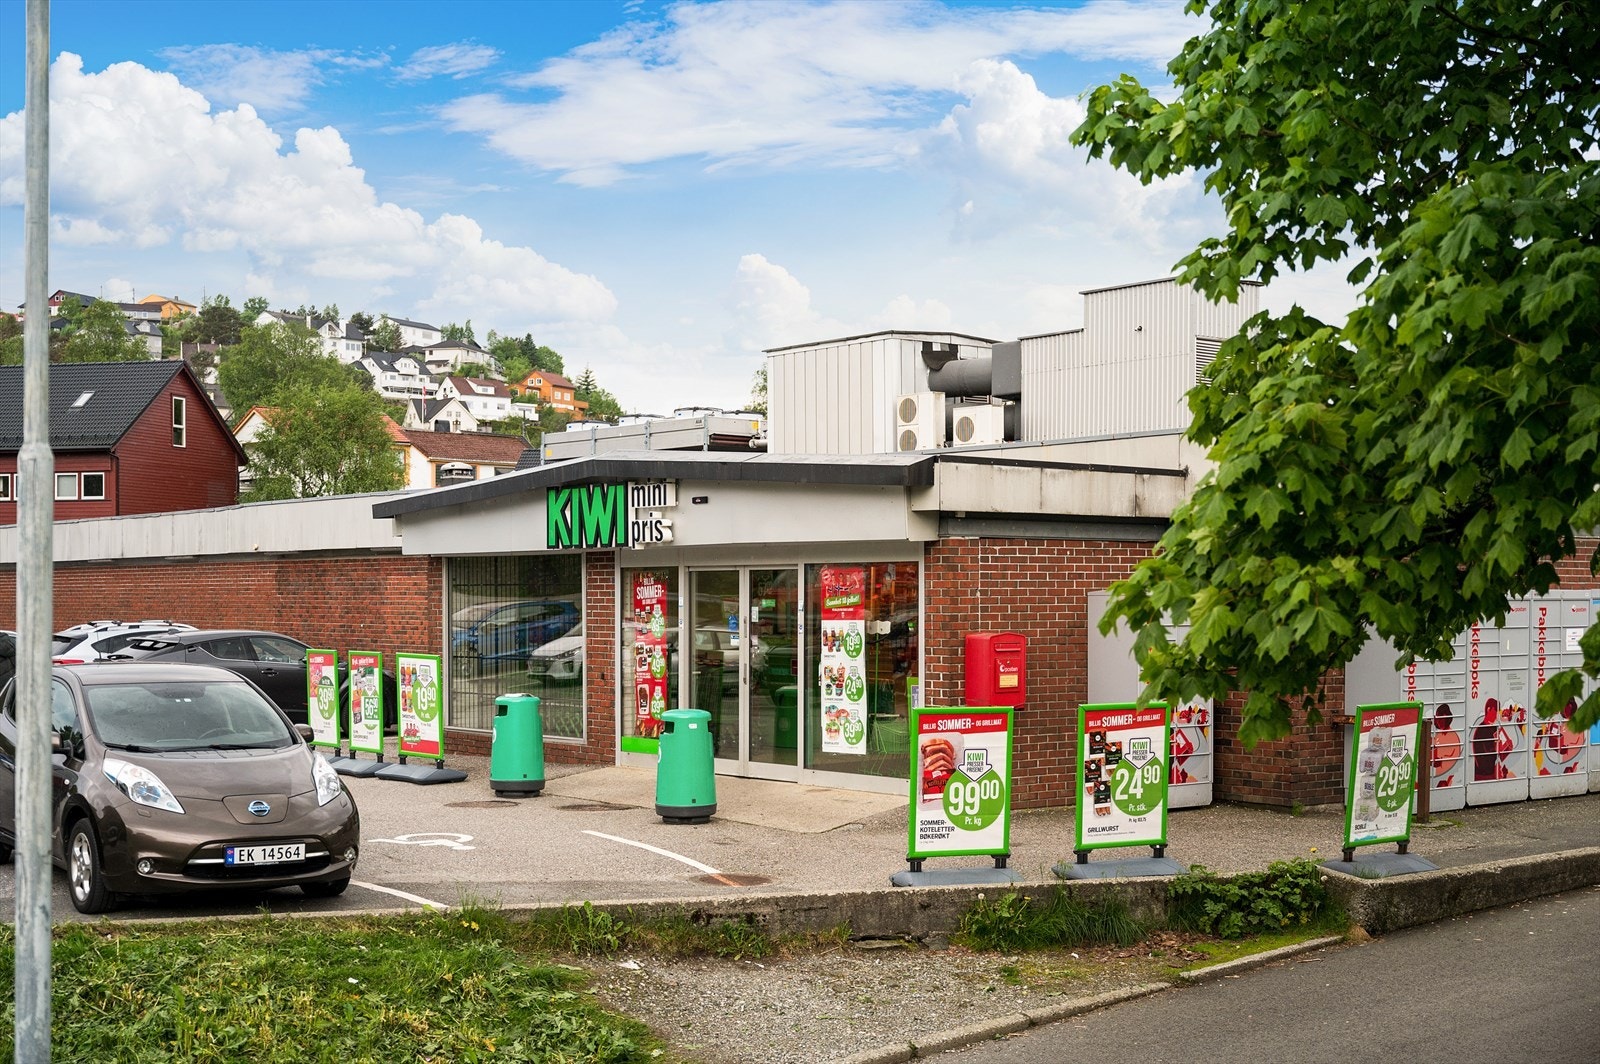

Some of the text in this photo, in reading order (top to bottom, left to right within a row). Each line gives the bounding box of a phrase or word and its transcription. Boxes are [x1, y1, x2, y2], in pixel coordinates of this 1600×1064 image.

[632, 479, 667, 507] mini
[547, 485, 627, 548] KIWI
[632, 512, 664, 549] pris
[637, 585, 664, 599] SOMMER-
[1538, 607, 1547, 687] Pakkebok
[1471, 619, 1480, 699] akkeboks
[415, 687, 436, 710] 1990
[937, 718, 975, 731] SOMMER-
[1102, 714, 1136, 727] SOMMER-
[1374, 713, 1396, 726] SOMMER
[1132, 741, 1148, 749] KIWI
[967, 752, 984, 761] KIWI
[1137, 803, 1147, 811] stk.
[965, 816, 982, 826] Pr. kg
[1088, 825, 1119, 833] GRILLWURST
[239, 846, 301, 861] EK 14564
